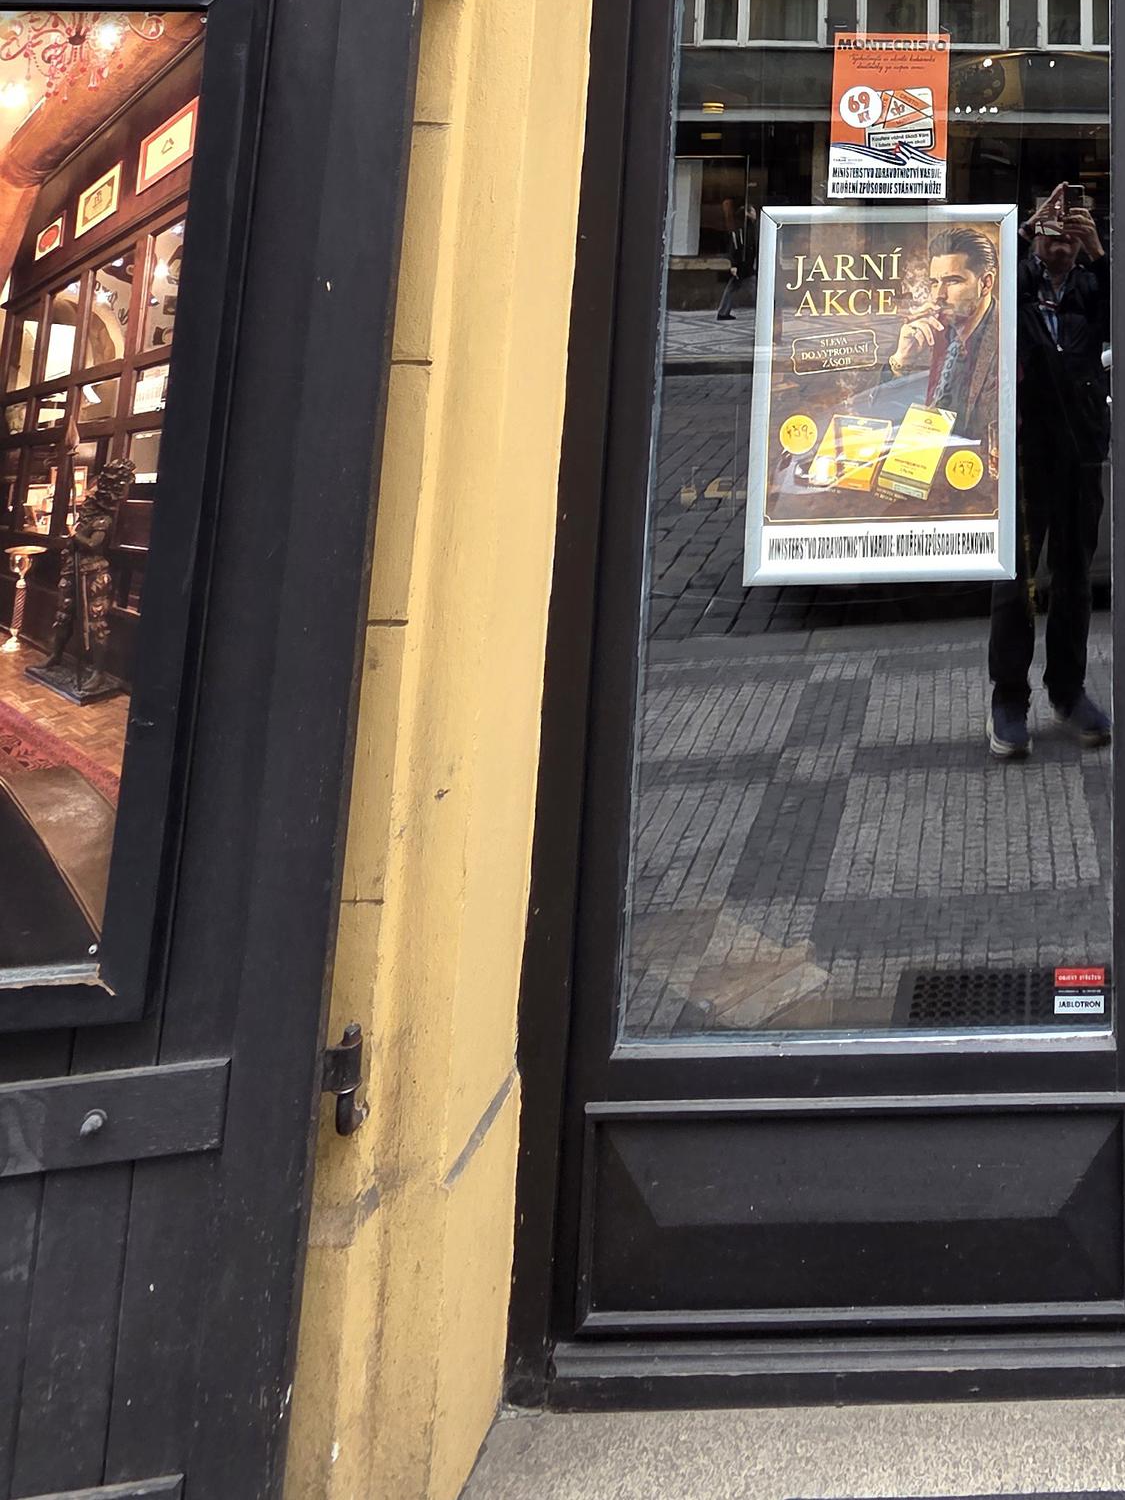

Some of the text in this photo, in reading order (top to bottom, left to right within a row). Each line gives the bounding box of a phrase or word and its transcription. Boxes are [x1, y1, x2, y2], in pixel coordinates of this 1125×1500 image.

[837, 38, 948, 52] MONTECRISTO
[848, 91, 871, 113] 69
[786, 247, 903, 290] JARNÍ
[794, 288, 898, 317] AKCE
[1058, 1000, 1101, 1008] JABLOTRON
